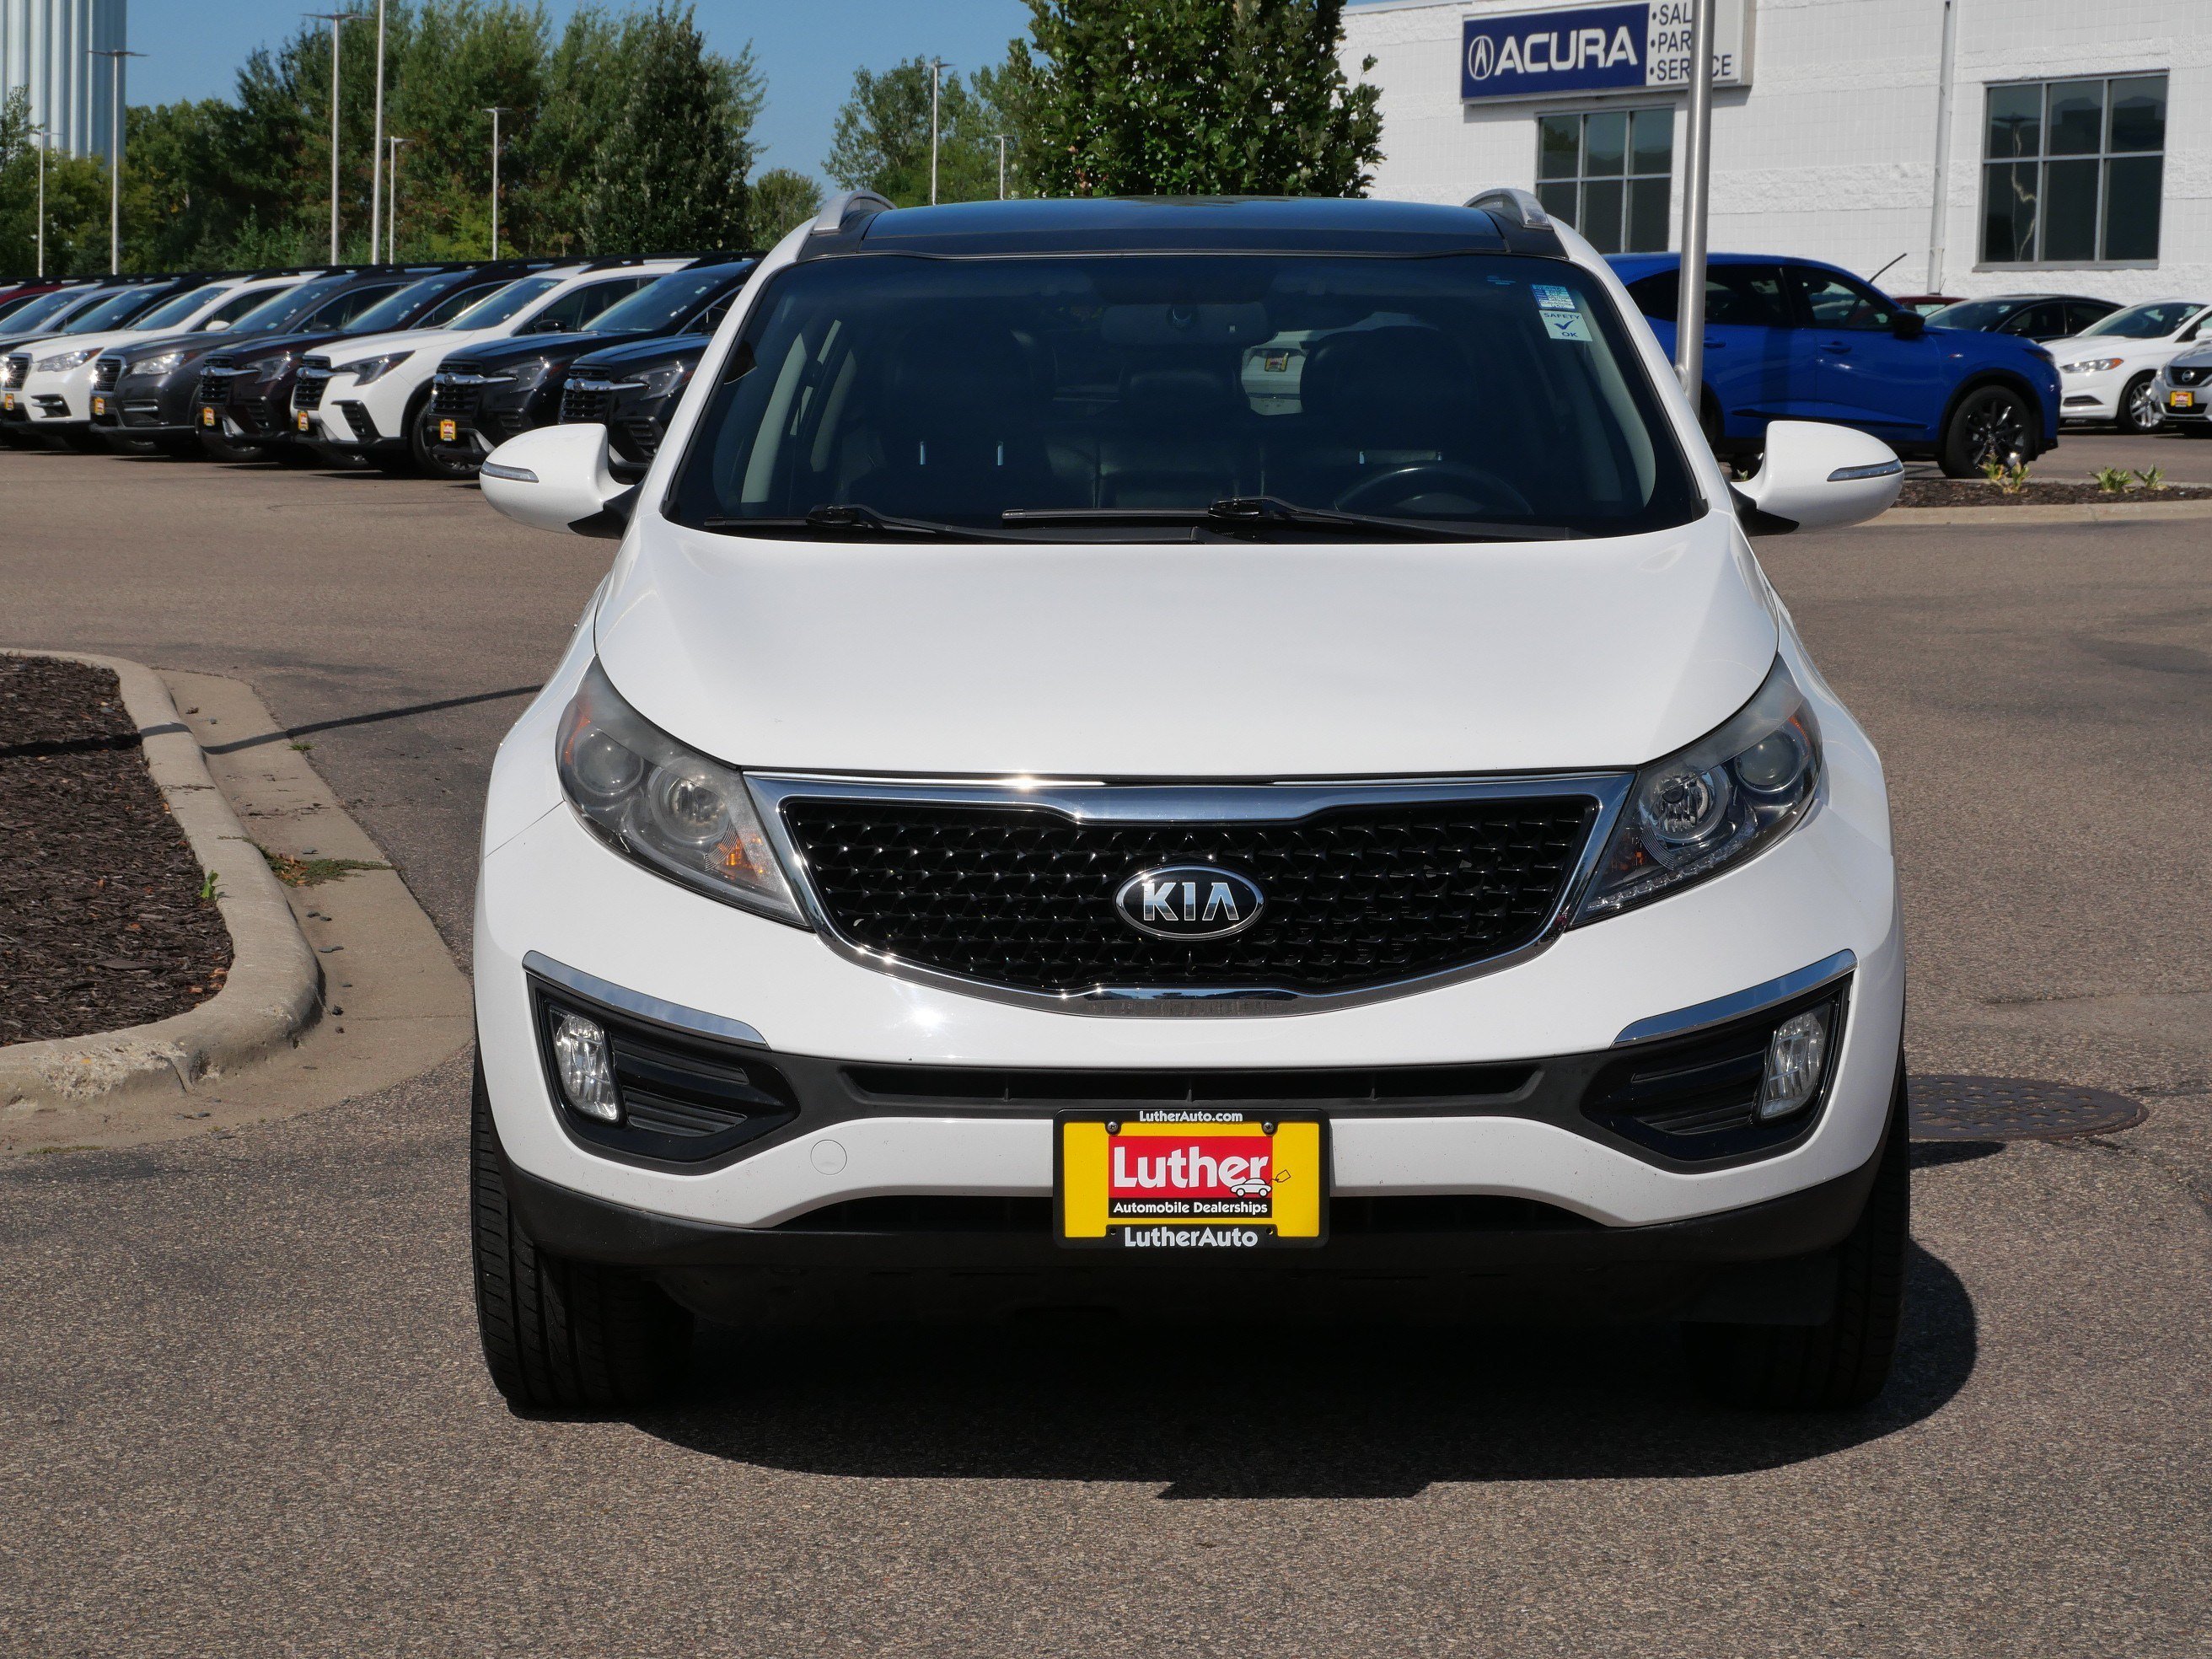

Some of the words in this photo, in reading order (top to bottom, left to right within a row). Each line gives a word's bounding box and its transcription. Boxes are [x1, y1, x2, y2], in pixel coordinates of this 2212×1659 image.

[1659, 3, 1692, 25] SAL
[1495, 26, 1638, 76] ACURA
[1658, 30, 1691, 53] PAR
[1657, 54, 1731, 81] SERCE
[1141, 882, 1239, 921] KIA
[1140, 1111, 1243, 1122] LutherAuto.com
[1114, 1146, 1270, 1189] Luther
[1113, 1202, 1189, 1214] Automobile
[1194, 1202, 1268, 1215] Dealerships
[1125, 1227, 1259, 1248] LutherAuto
